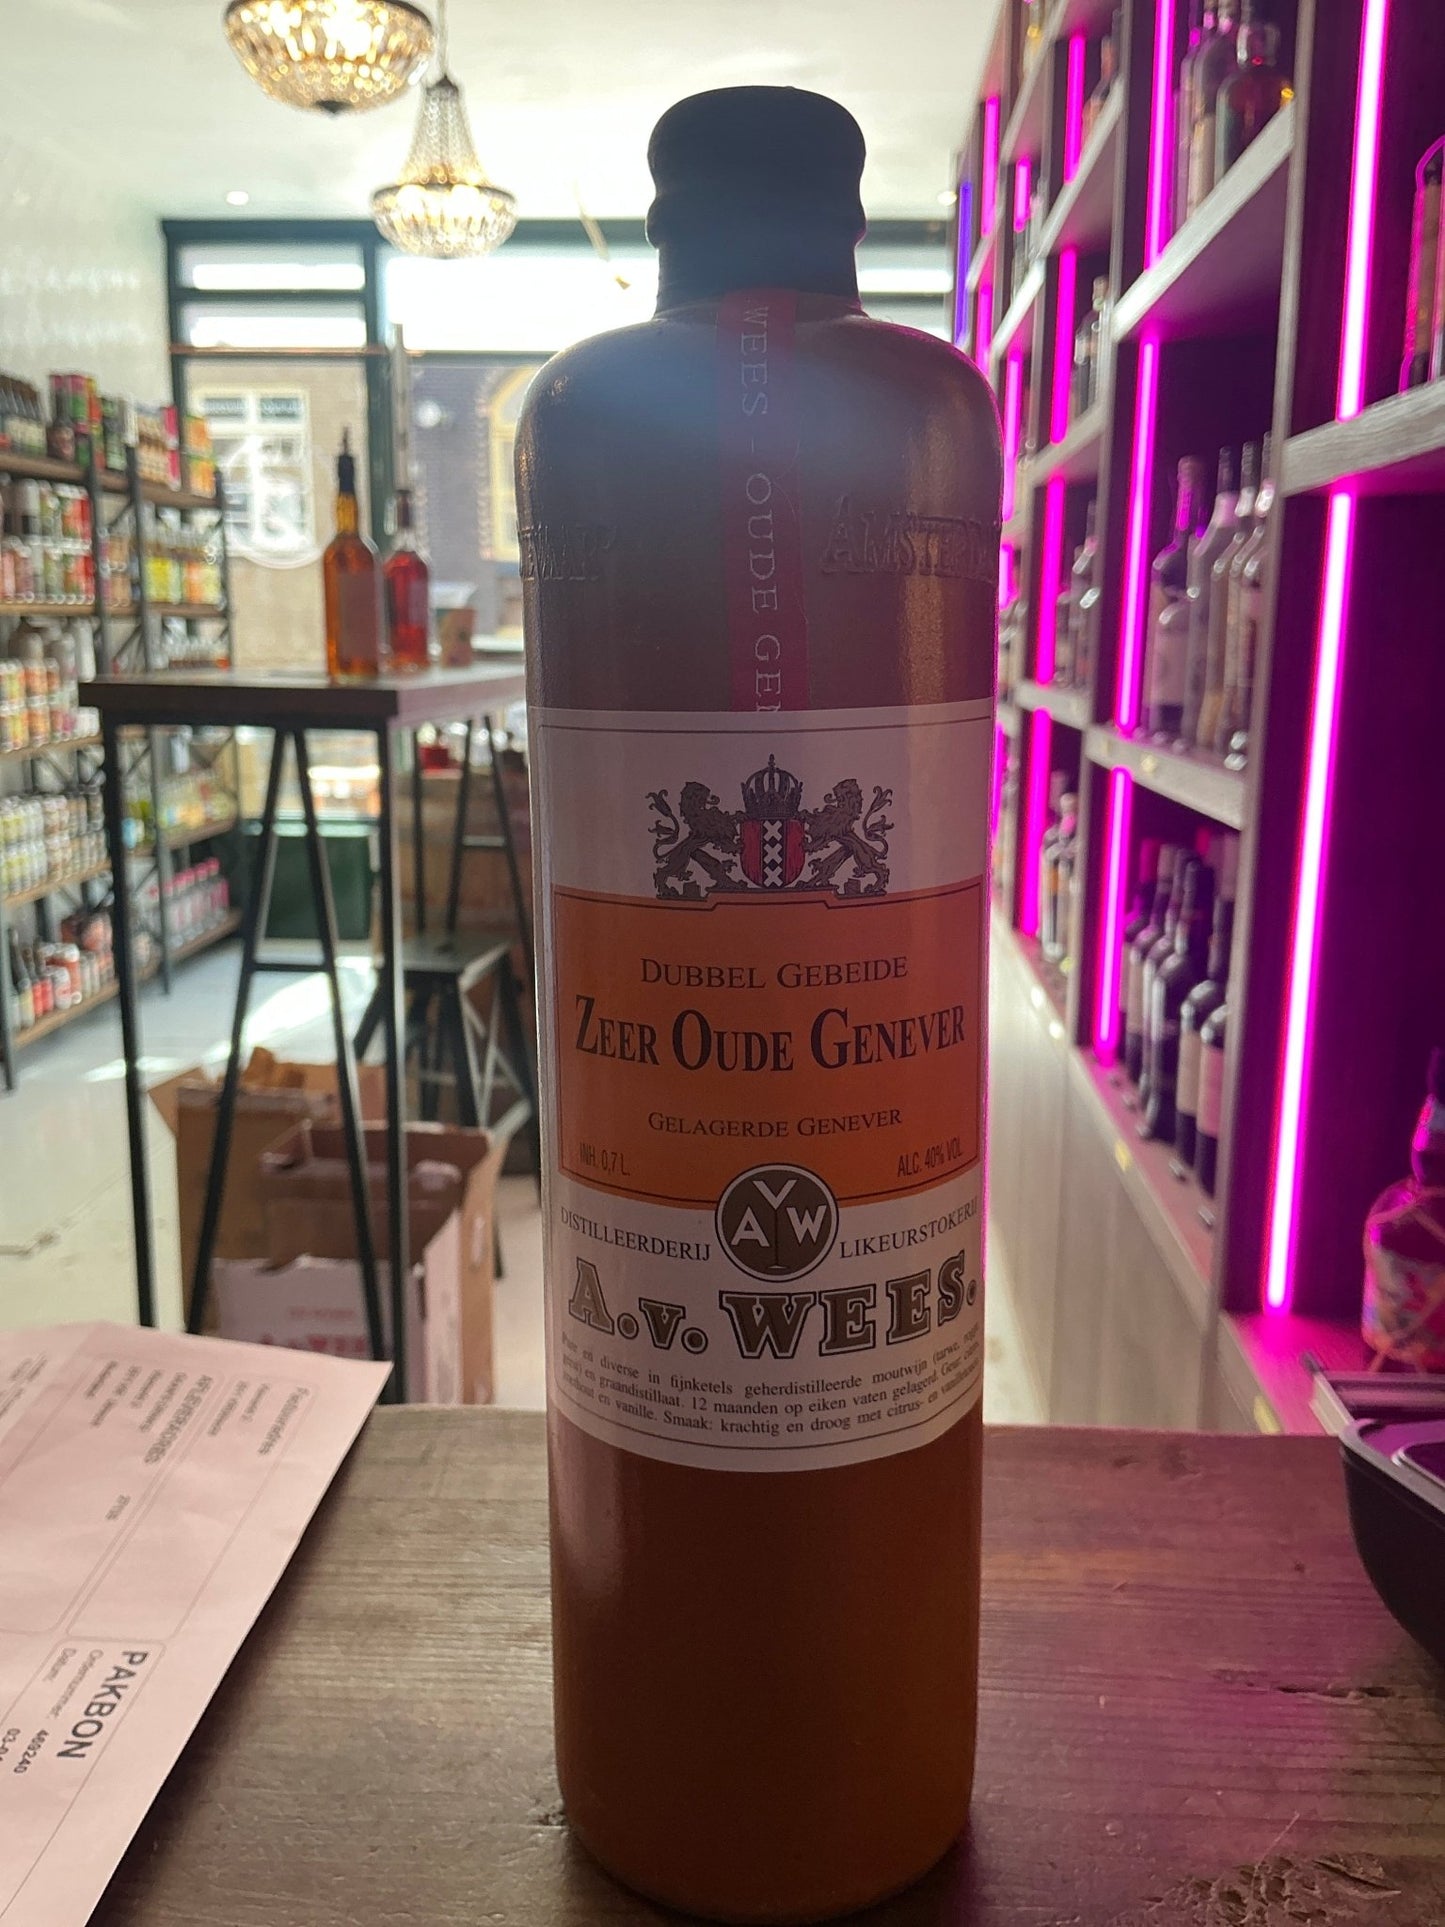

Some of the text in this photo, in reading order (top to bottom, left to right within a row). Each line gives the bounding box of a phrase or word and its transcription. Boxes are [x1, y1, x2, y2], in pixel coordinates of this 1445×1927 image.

[746, 472, 778, 614] OUDE
[640, 956, 908, 990] DUBBEL GEBEIDE
[575, 994, 966, 1073] ZEER OUDE GENEVER
[648, 1108, 902, 1139] GELAGERDE GENEVER
[601, 1149, 618, 1176] 0,7
[897, 1151, 923, 1178] ALC.
[924, 1143, 944, 1169] 40%
[561, 1206, 711, 1261] DISTILLEERDERIJ
[599, 1375, 686, 1409] graandistillaat.
[692, 1396, 708, 1411] 12
[714, 1401, 779, 1415] maanden
[784, 1403, 804, 1418] op
[808, 1398, 847, 1413] eiken
[853, 1389, 888, 1406] vaten
[600, 1355, 640, 1380] diverse
[648, 1369, 661, 1385] in
[670, 1374, 733, 1395] fijnketels
[744, 1375, 863, 1400] geherdistilleerde
[872, 1359, 928, 1385] moutwijn
[663, 1410, 714, 1431] Smaak:
[720, 1417, 781, 1437] krachtig
[786, 1420, 805, 1433] en
[810, 1416, 851, 1432] droog
[857, 1408, 883, 1425] met
[887, 1398, 925, 1418] citrus-
[57, 1650, 149, 1758] PAKBON
